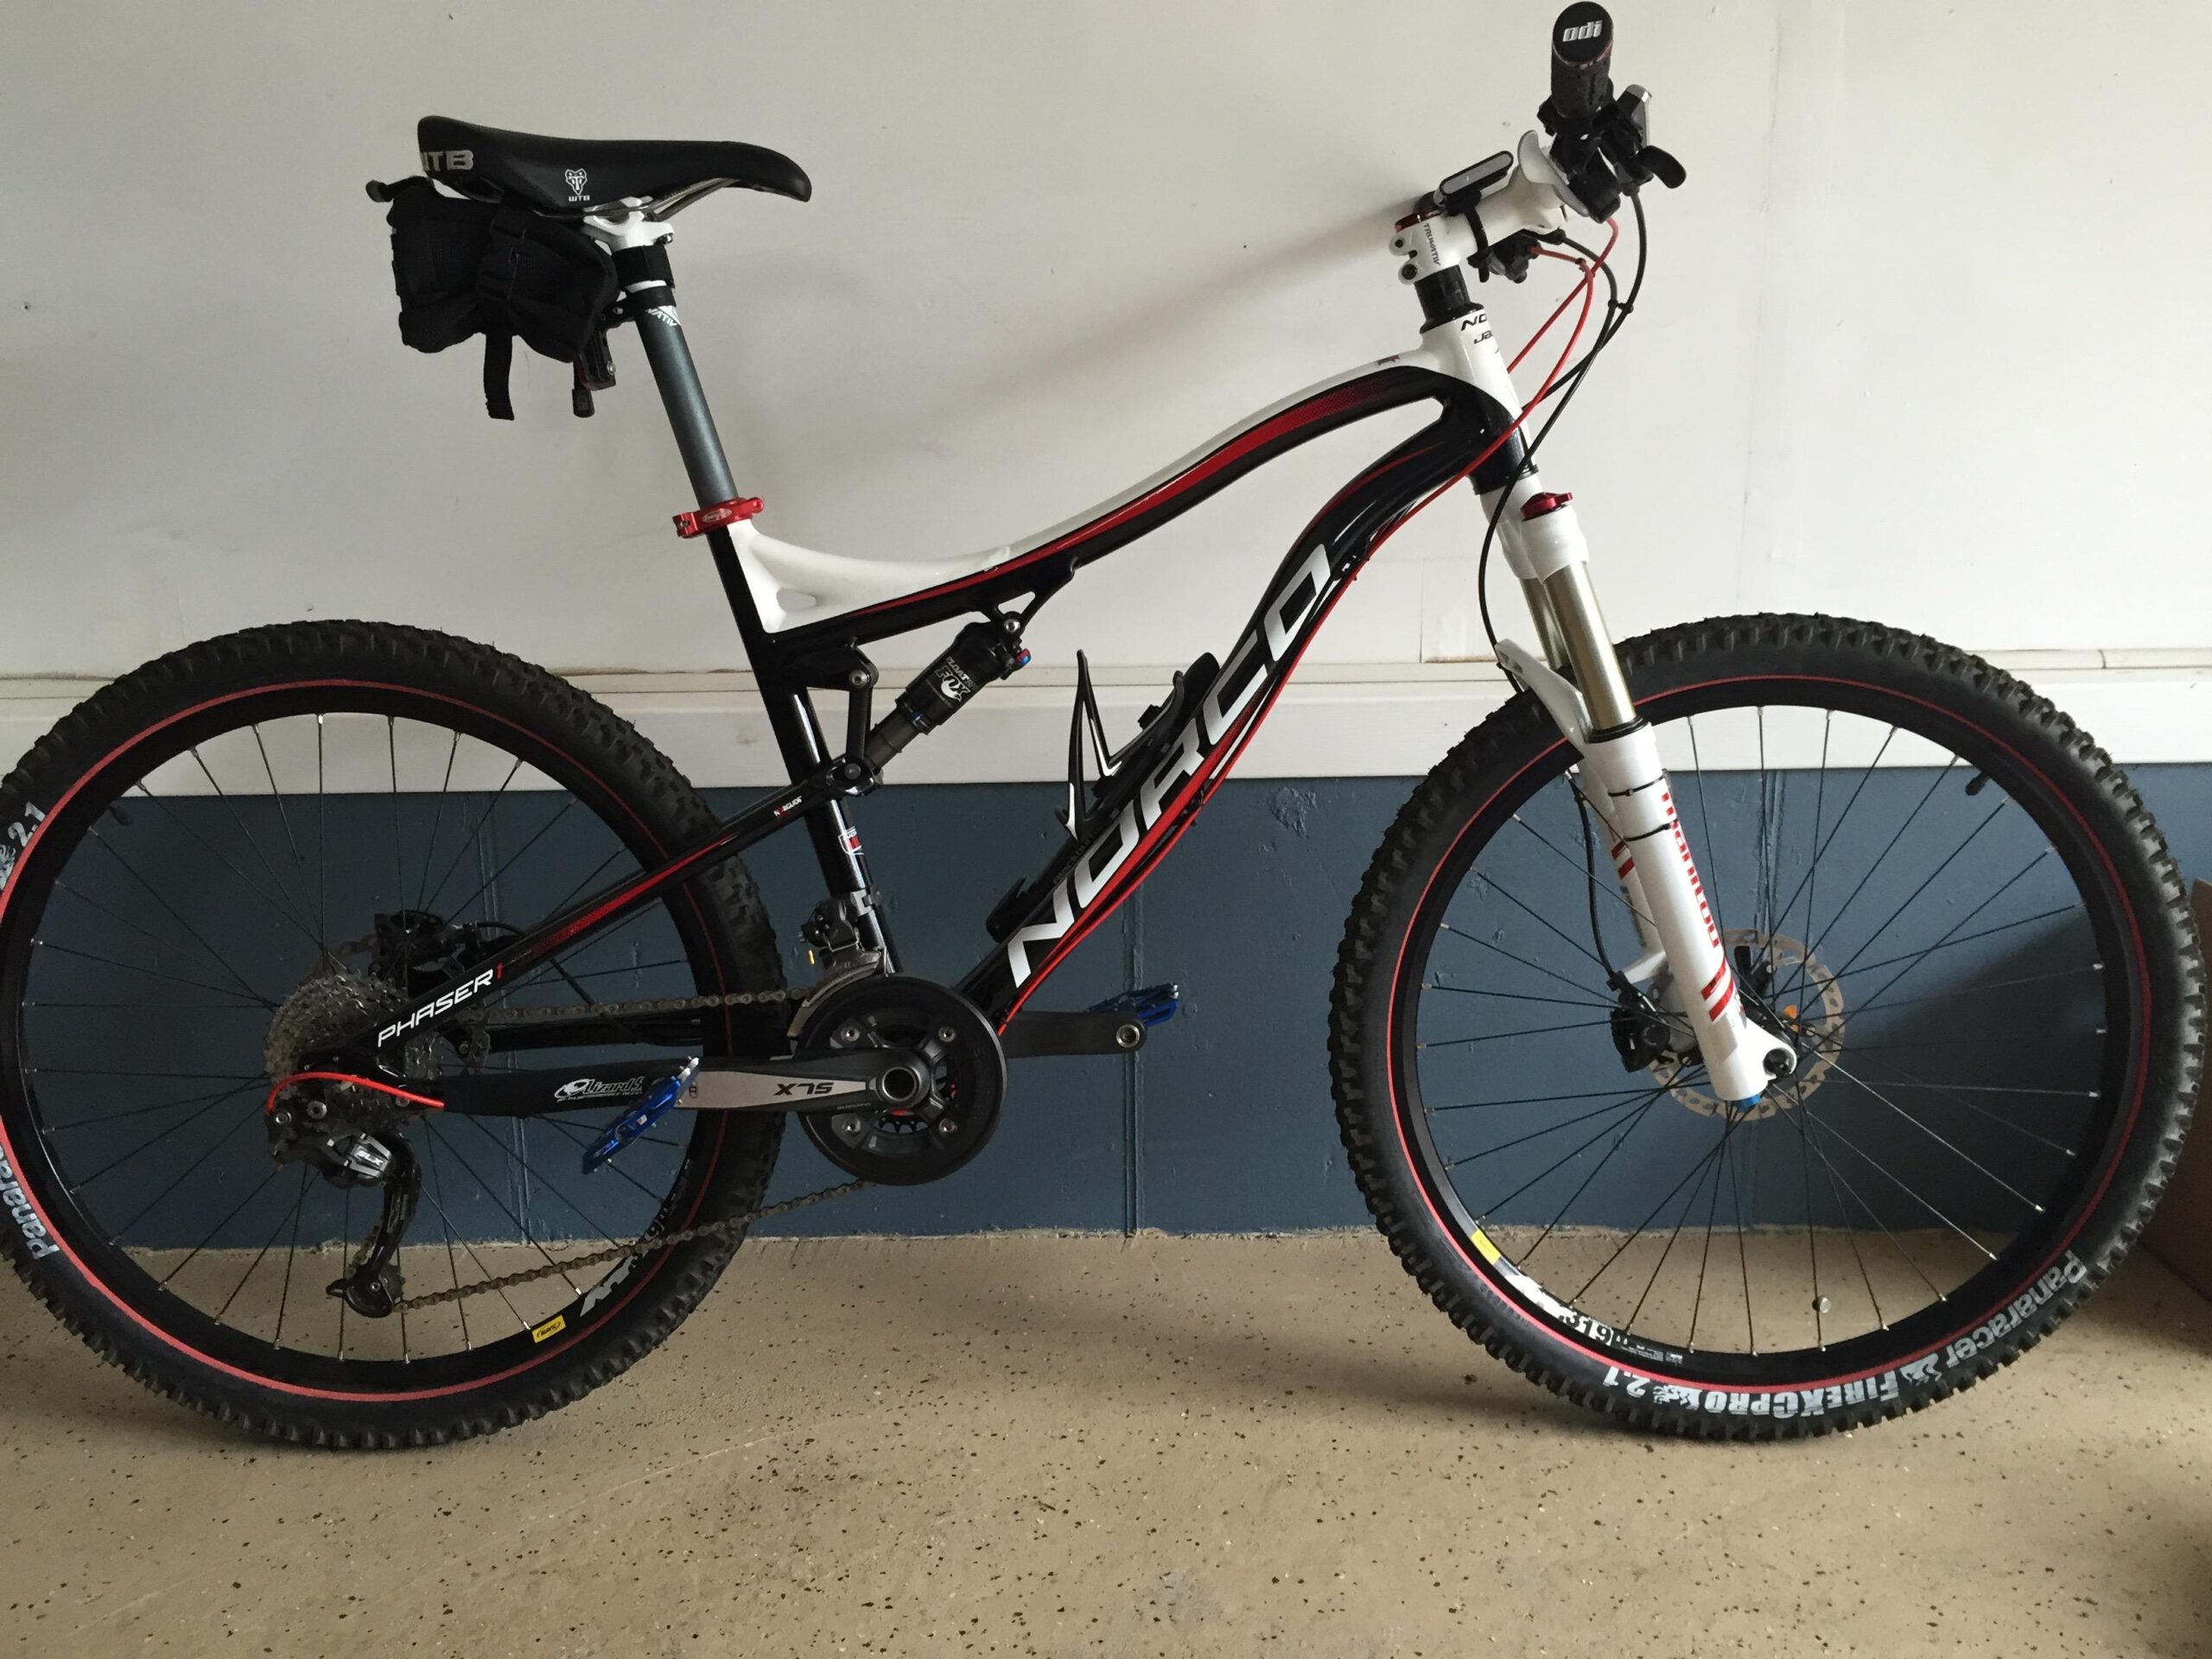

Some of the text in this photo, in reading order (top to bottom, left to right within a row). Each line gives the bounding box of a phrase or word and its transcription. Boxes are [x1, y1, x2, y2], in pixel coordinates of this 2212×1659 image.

[1562, 20, 1603, 42] odi
[1424, 222, 1442, 266] TRUVATIV
[647, 308, 678, 327] VATIV
[934, 664, 971, 702] FOX
[1007, 543, 1331, 988] NORCO
[7, 801, 47, 848] 2.1
[378, 969, 493, 1048] PHASER
[773, 1082, 835, 1096] SLX
[356, 1149, 385, 1167] SLX
[0, 1145, 60, 1260] Panara
[1946, 1249, 2088, 1368] Panaracer
[1602, 1365, 1651, 1398] 2.1
